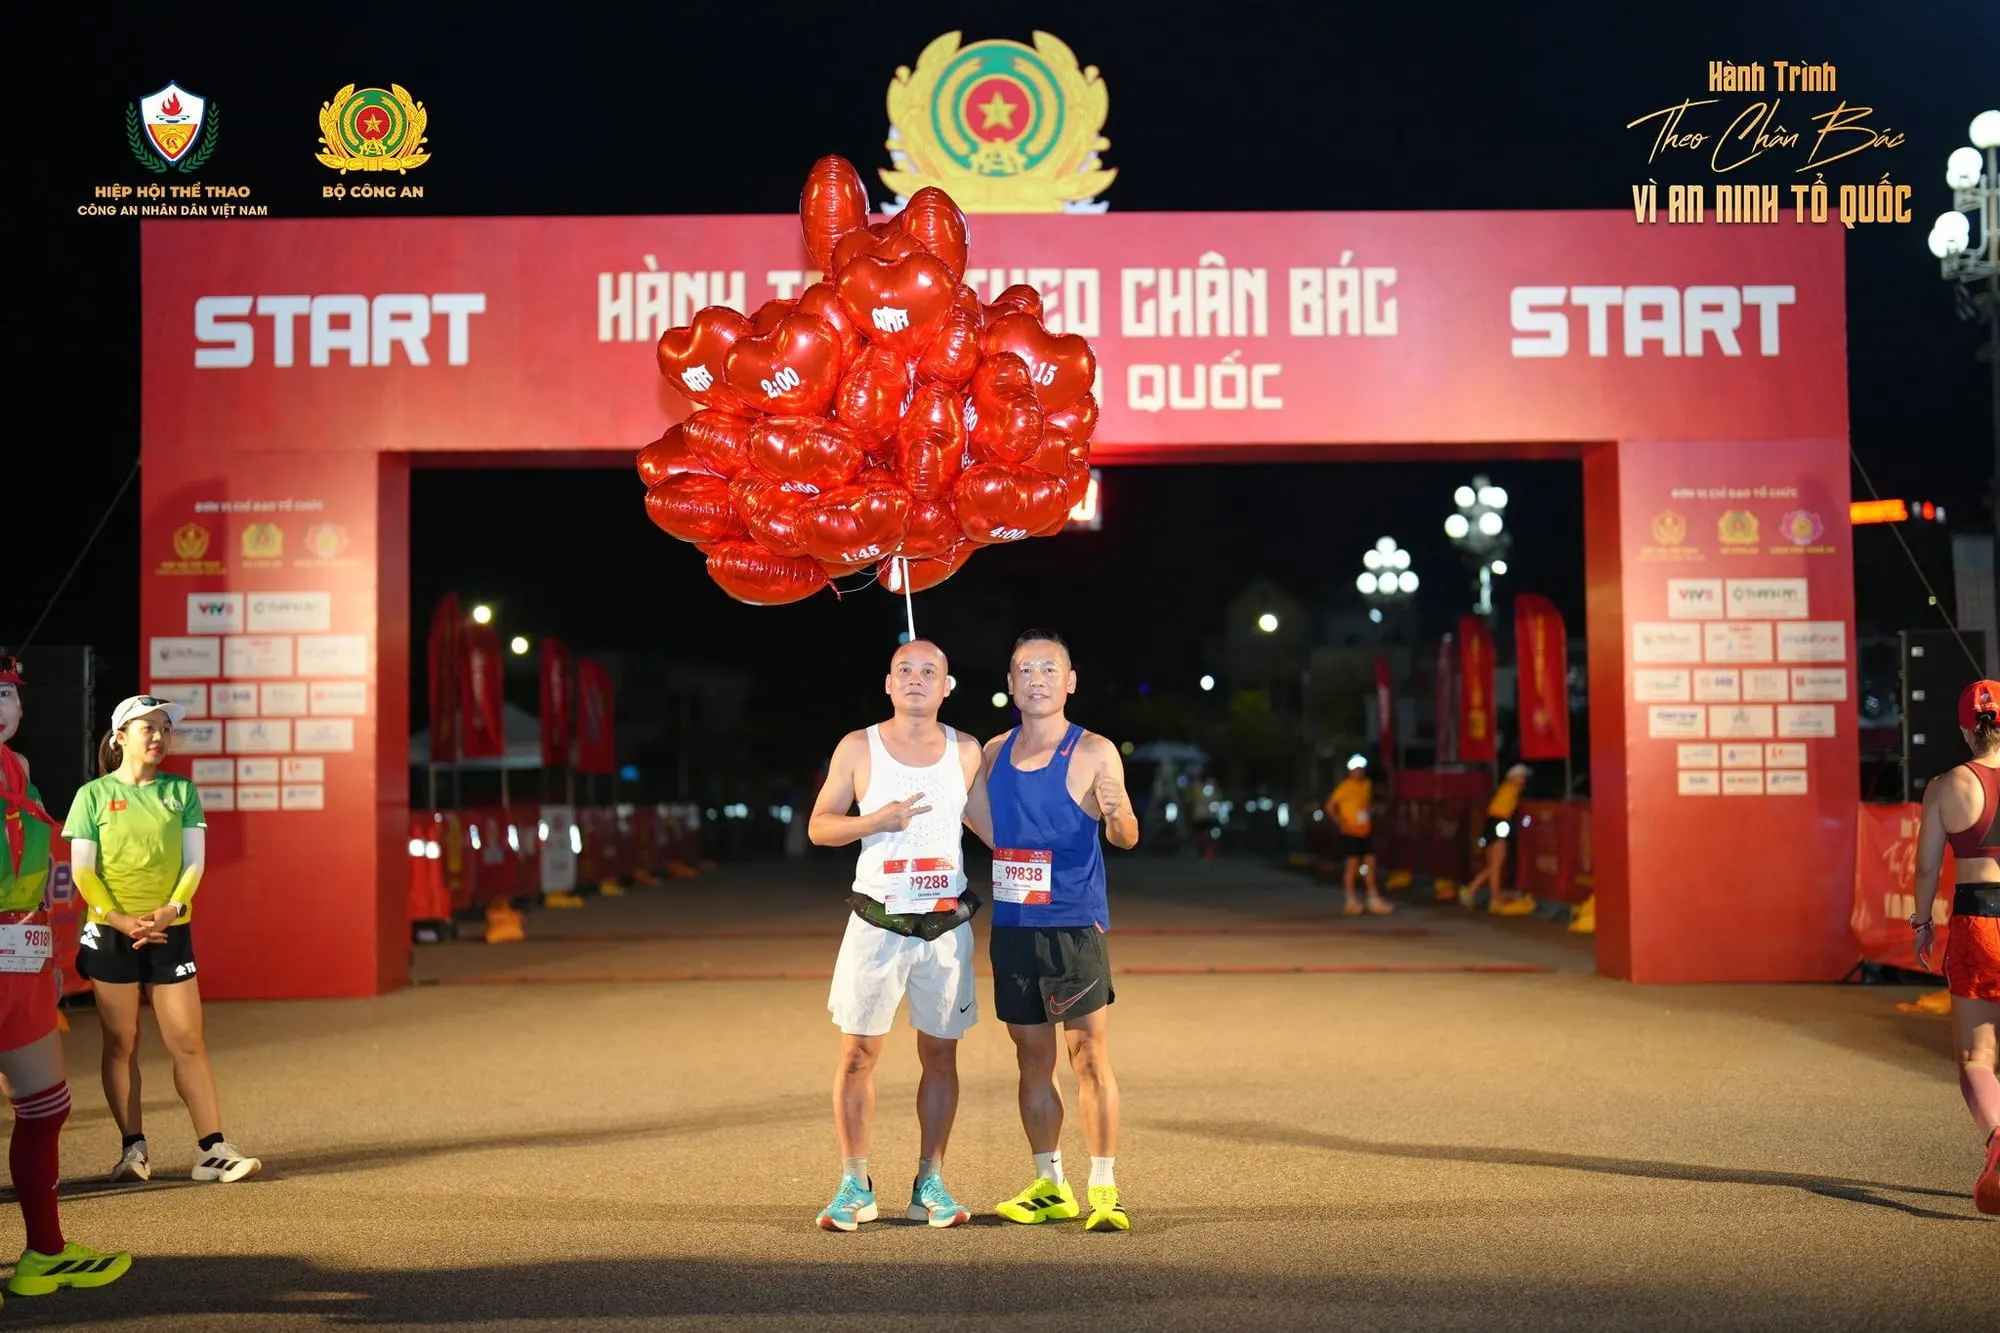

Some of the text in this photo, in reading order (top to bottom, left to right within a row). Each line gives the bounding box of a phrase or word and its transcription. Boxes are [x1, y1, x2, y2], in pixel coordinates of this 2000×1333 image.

[598, 254, 746, 342] HÀNH
[1510, 285, 1796, 358] START
[194, 293, 486, 369] START
[761, 366, 800, 399] 2:00
[1027, 354, 1058, 387] :15
[1126, 348, 1284, 413] QUỐC
[841, 543, 881, 562] 1:45
[1005, 866, 1043, 881] 99838
